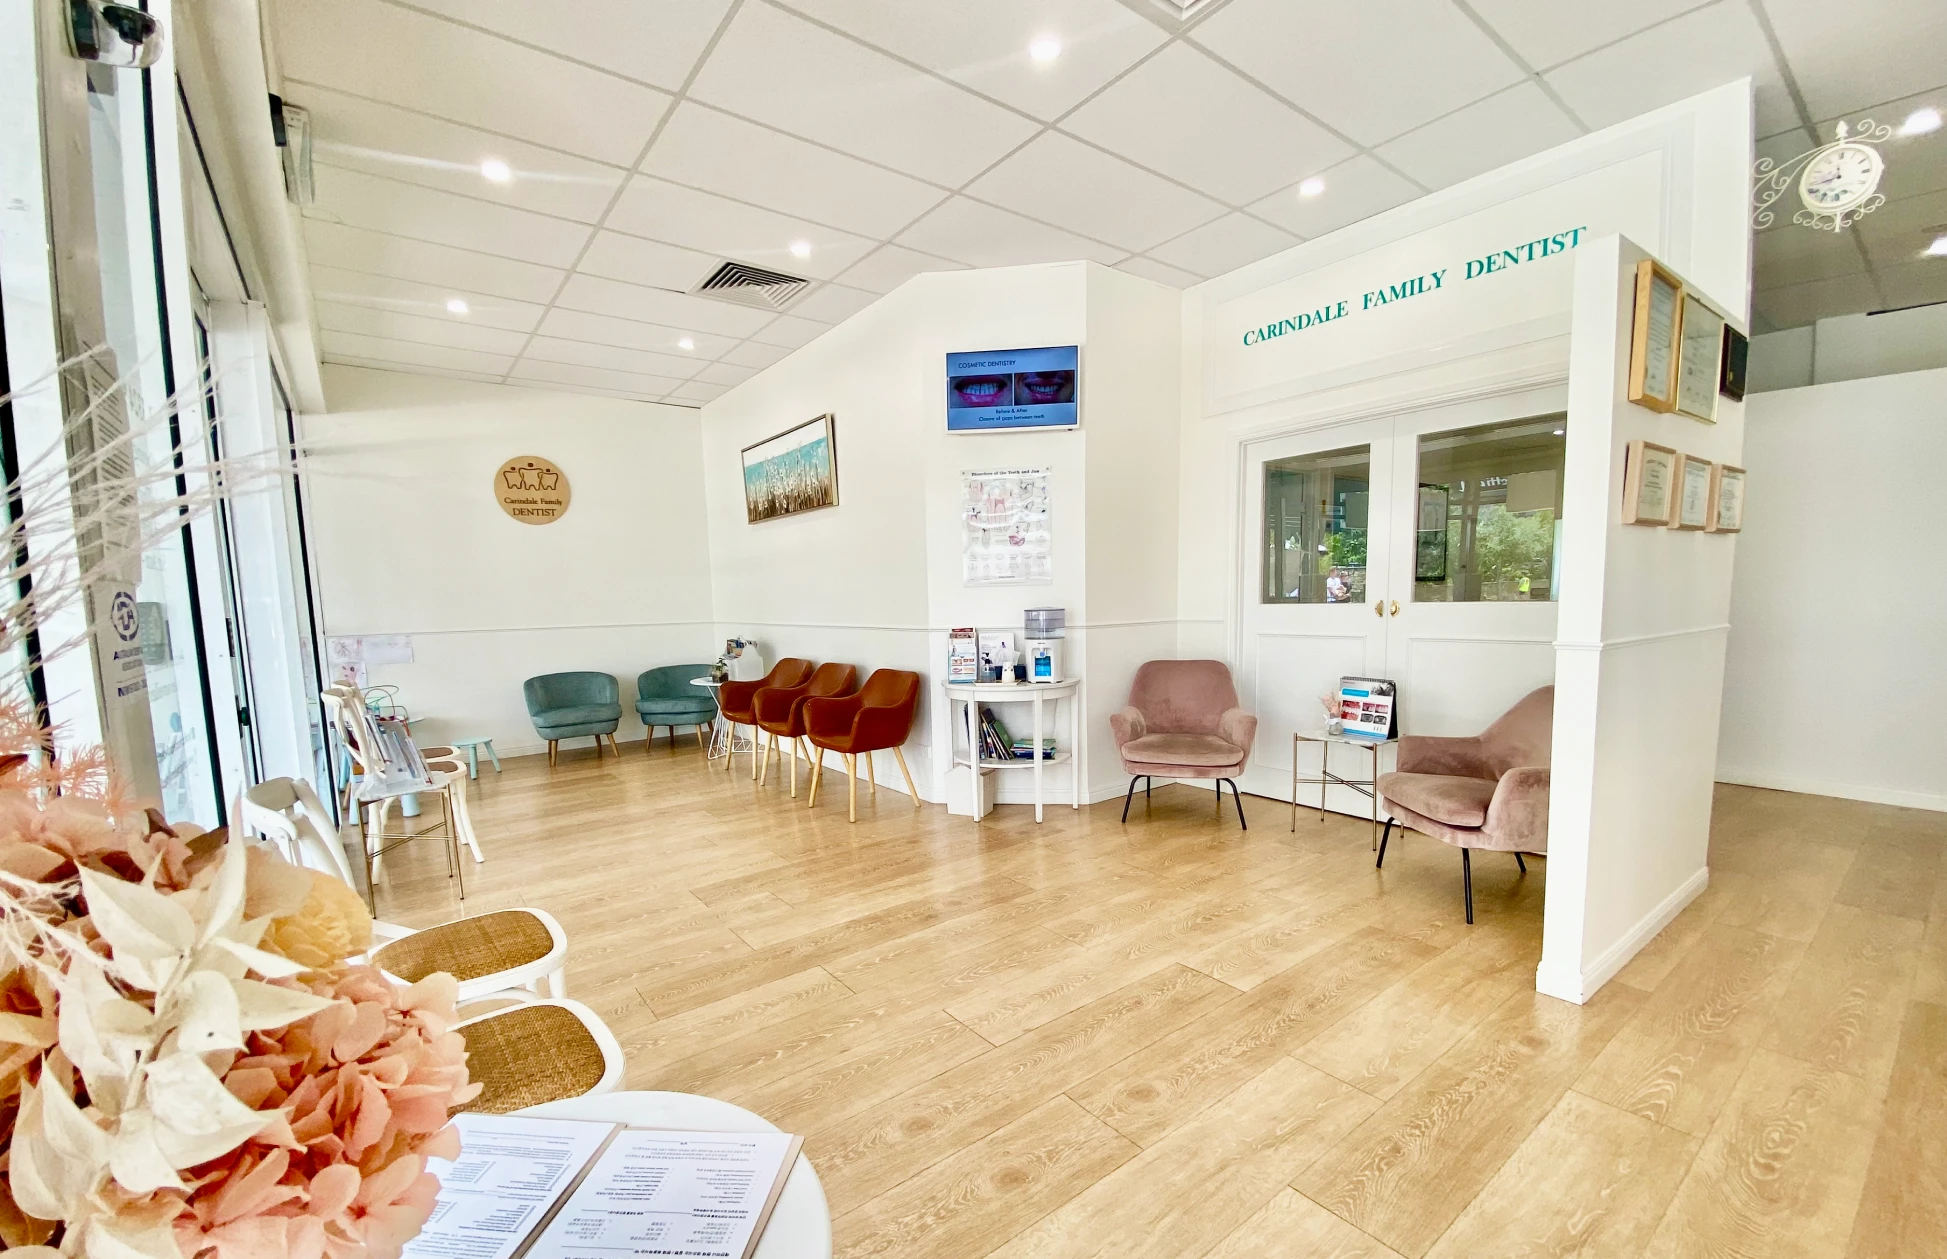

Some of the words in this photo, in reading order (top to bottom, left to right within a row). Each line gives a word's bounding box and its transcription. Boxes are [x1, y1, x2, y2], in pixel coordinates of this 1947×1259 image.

[1243, 300, 1349, 346] CARINDALE
[1362, 269, 1448, 311] FAMILY
[1464, 226, 1587, 281] DENTIST
[958, 361, 987, 369] COSMETIC
[504, 496, 539, 505] Carindale
[540, 497, 563, 506] Family
[512, 508, 557, 517] DENTIST
